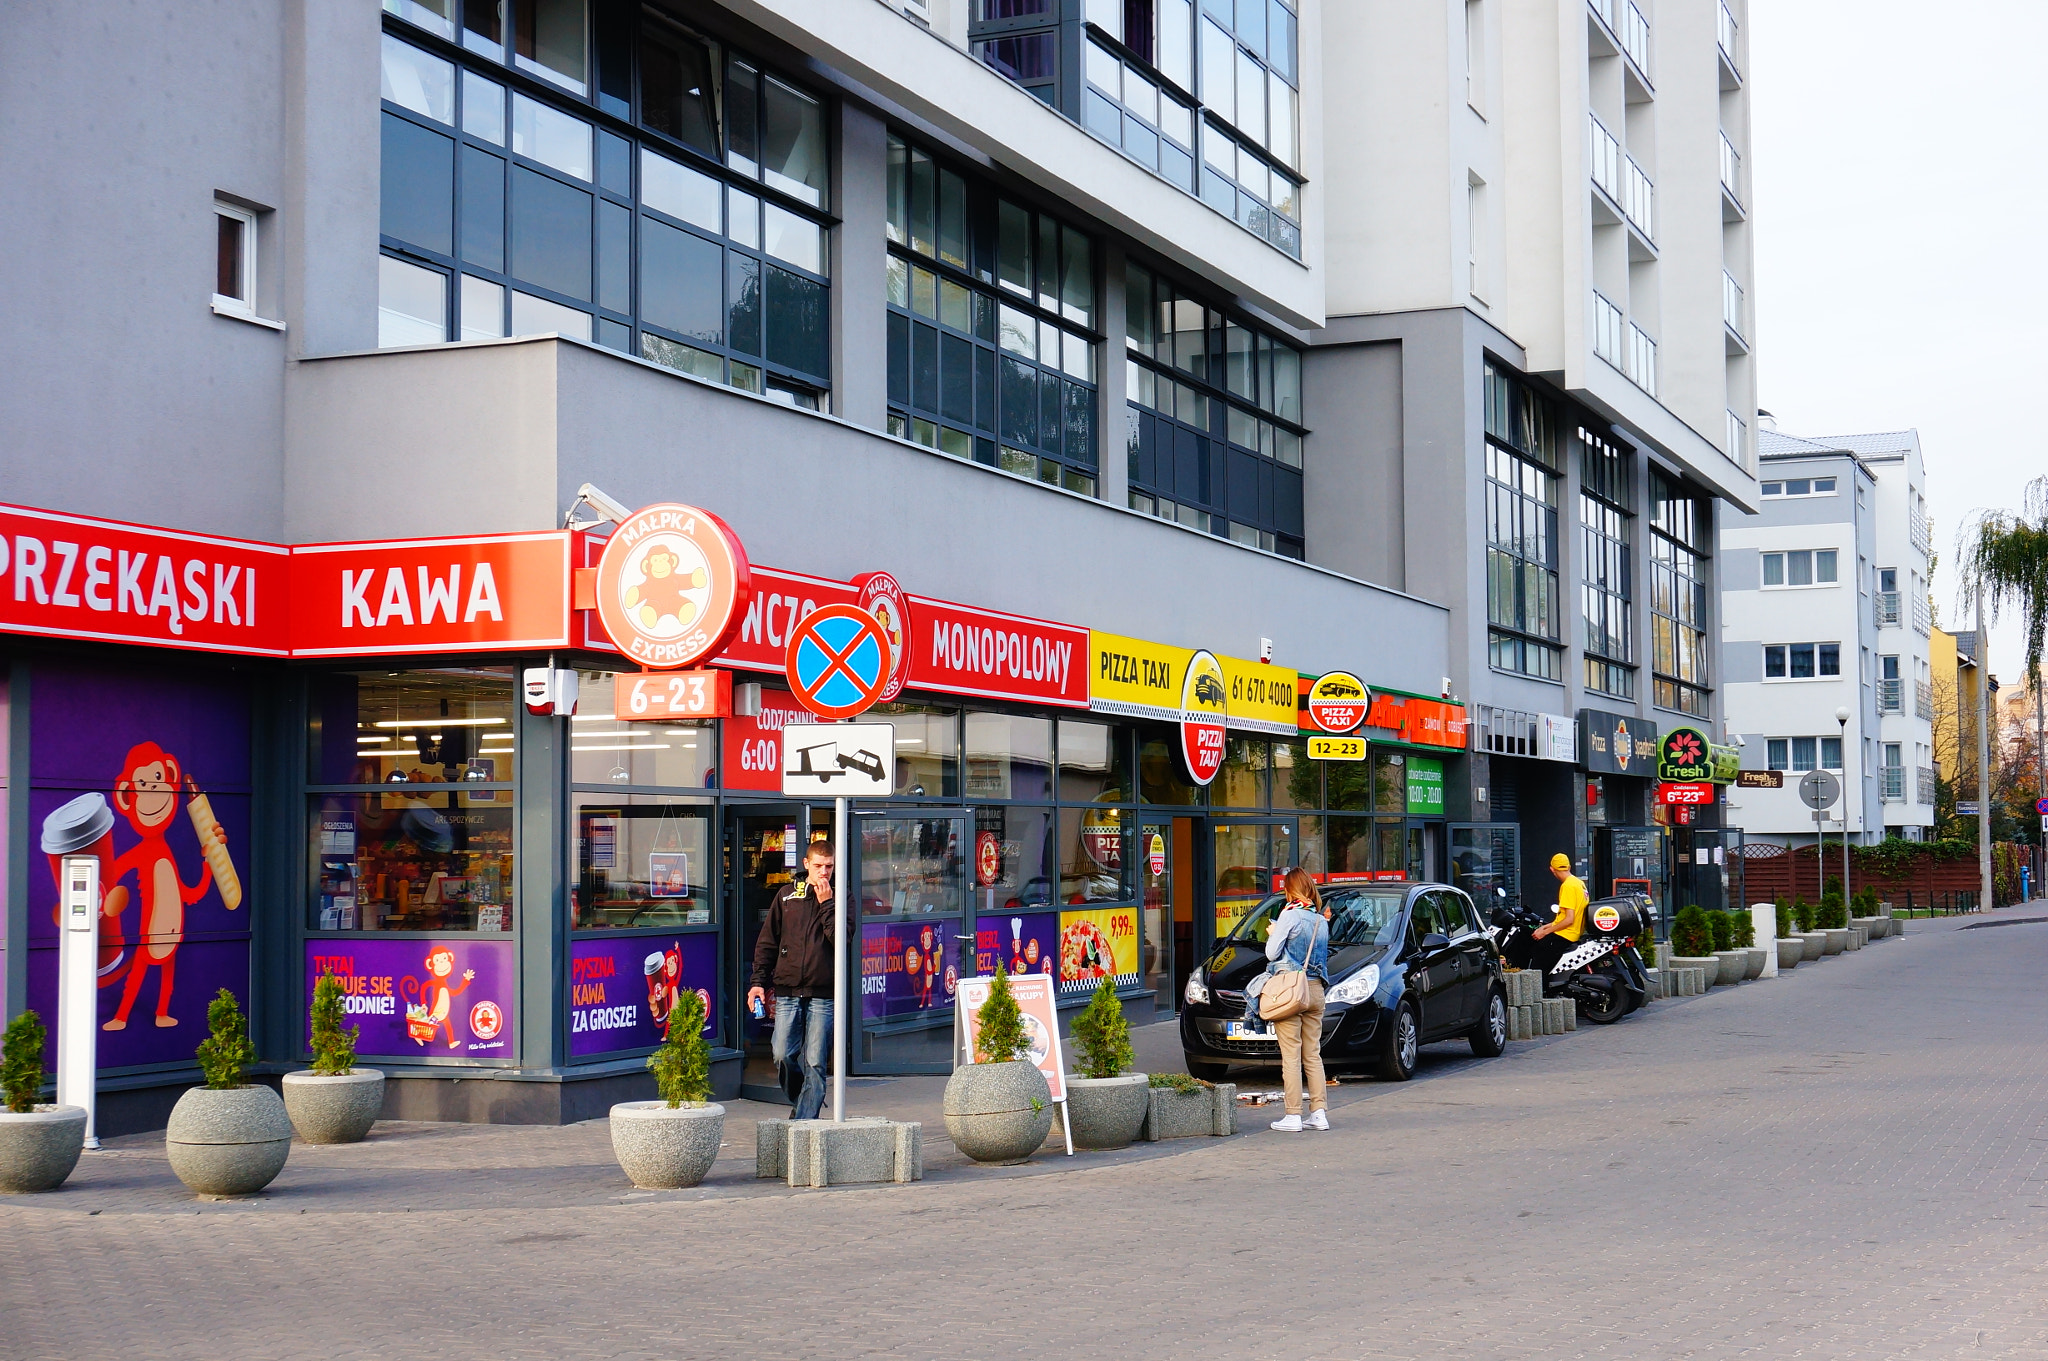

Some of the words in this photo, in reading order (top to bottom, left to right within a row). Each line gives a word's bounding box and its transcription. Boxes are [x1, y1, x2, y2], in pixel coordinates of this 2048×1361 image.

[621, 512, 696, 546] MAŁPKA
[0, 534, 255, 635] RZEKĄSKI
[341, 562, 503, 628] KAWA
[868, 578, 899, 603] MAŁPKA
[630, 628, 708, 660] EXPRESS
[931, 619, 1073, 695] MONOPOLOWY
[1100, 651, 1139, 685] PIZZA
[1142, 658, 1170, 690] TAXI
[1232, 675, 1244, 701] 61
[1247, 677, 1265, 704] 670
[1268, 680, 1292, 708] 4000
[1321, 707, 1354, 716] PIZZA
[1324, 717, 1350, 726] TAXI
[1197, 729, 1223, 748] PIZZA
[1591, 731, 1606, 752] Pizza
[741, 738, 776, 772] 6:00
[1199, 750, 1219, 768] TAXI
[1667, 765, 1704, 777] Fresh
[1744, 772, 1770, 781] Fresh
[323, 822, 354, 831] OGŁOSZENIA
[1097, 837, 1121, 849] PIZ
[1102, 850, 1121, 862] TA
[1111, 914, 1129, 940] 9,99
[572, 956, 616, 984] PYSZNA
[370, 976, 393, 997] SIĘ
[572, 983, 607, 1006] KAWA
[336, 996, 396, 1015] GODNIE!
[572, 1010, 588, 1033] ZA
[589, 1005, 637, 1030] GROSZE!
